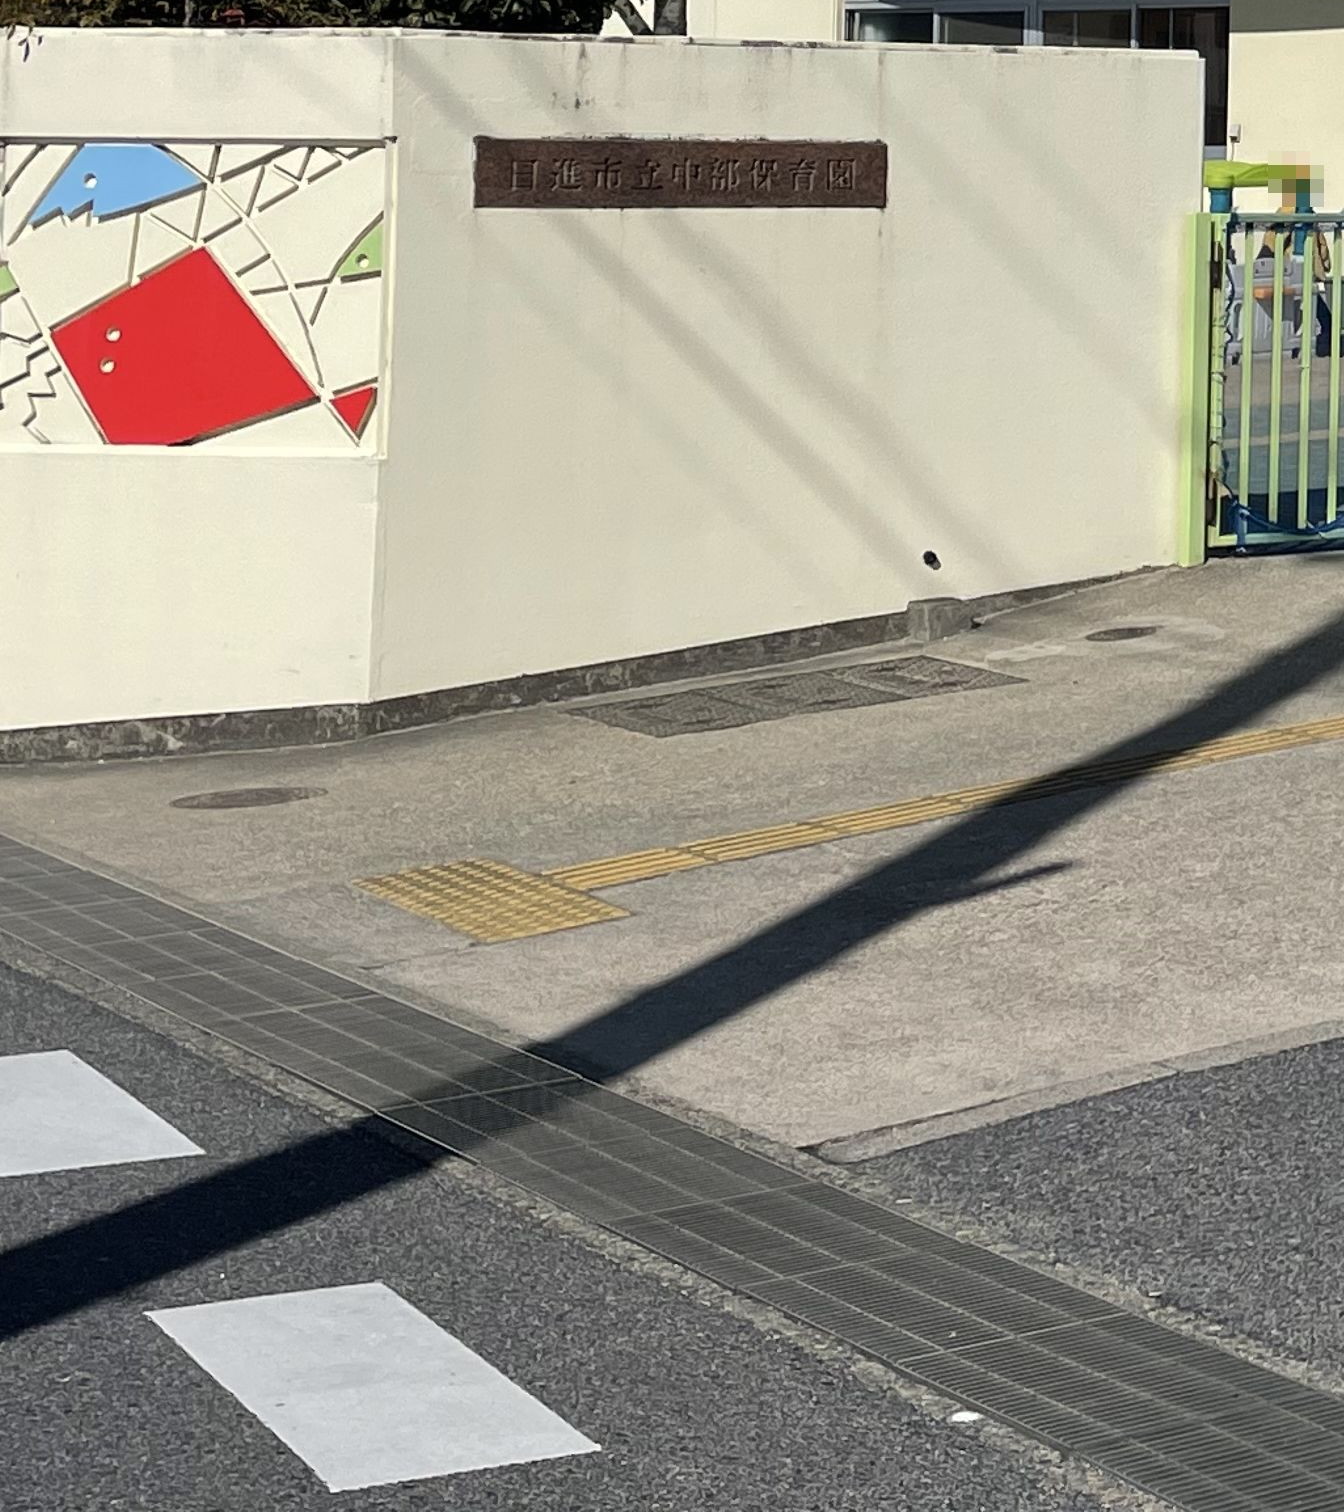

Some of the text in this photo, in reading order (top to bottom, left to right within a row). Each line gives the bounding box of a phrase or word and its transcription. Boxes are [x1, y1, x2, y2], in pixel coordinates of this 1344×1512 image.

[509, 156, 858, 193] 日進市立中部保育園
